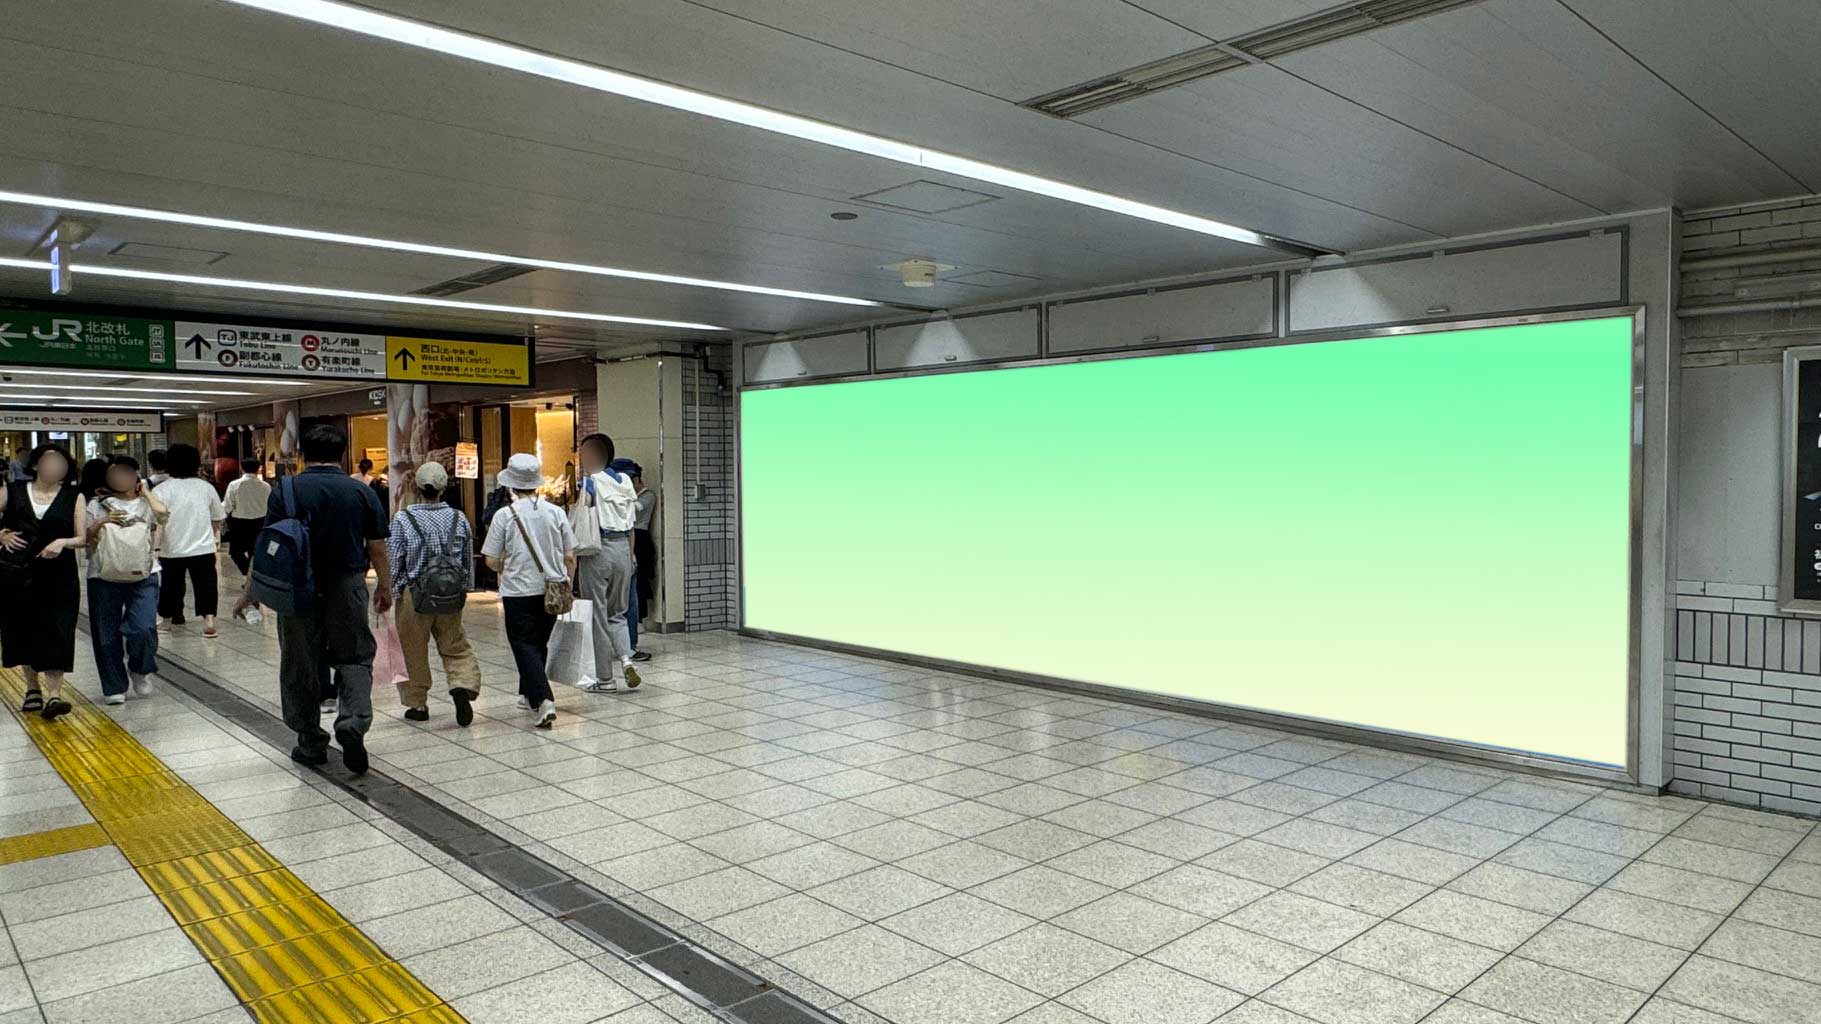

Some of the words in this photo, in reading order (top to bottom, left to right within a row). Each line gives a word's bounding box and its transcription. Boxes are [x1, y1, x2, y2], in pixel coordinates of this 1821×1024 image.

[32, 319, 82, 342] JR
[86, 321, 130, 336] 北改札
[85, 334, 116, 345] North
[119, 337, 145, 346] Gate
[239, 330, 292, 343] 東武東上線
[320, 336, 360, 347] 丸ノ内線
[239, 341, 257, 349] Tobu
[260, 342, 276, 350] Line
[320, 346, 362, 354] Marunouchi
[239, 351, 283, 362] 副都心線
[320, 355, 361, 366] 有楽町線
[420, 353, 438, 361] West
[239, 361, 281, 371] Fukutoshin
[283, 363, 299, 371] Line
